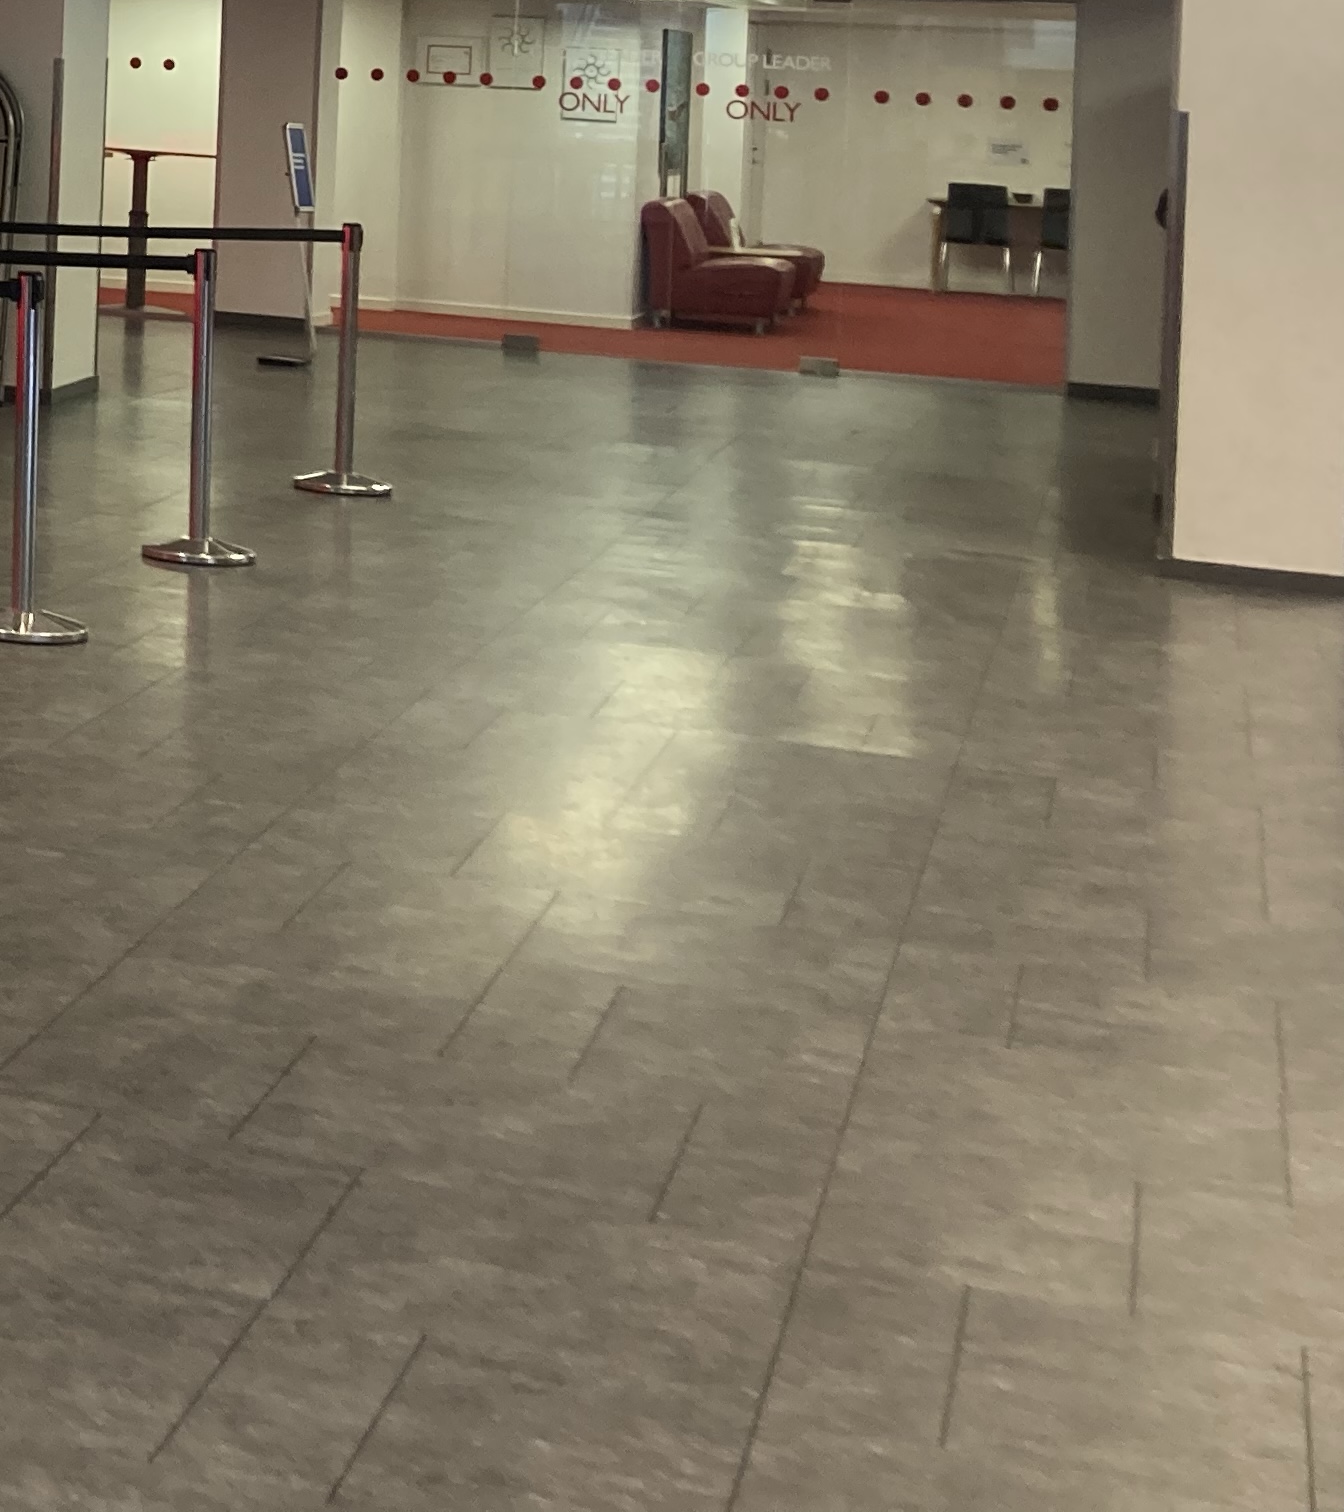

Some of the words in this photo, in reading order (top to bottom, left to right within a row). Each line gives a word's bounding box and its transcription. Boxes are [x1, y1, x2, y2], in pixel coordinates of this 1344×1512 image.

[692, 51, 758, 68] GROUP
[763, 53, 832, 70] LEADER
[559, 92, 631, 114] ONLY
[726, 99, 802, 122] ONLY
